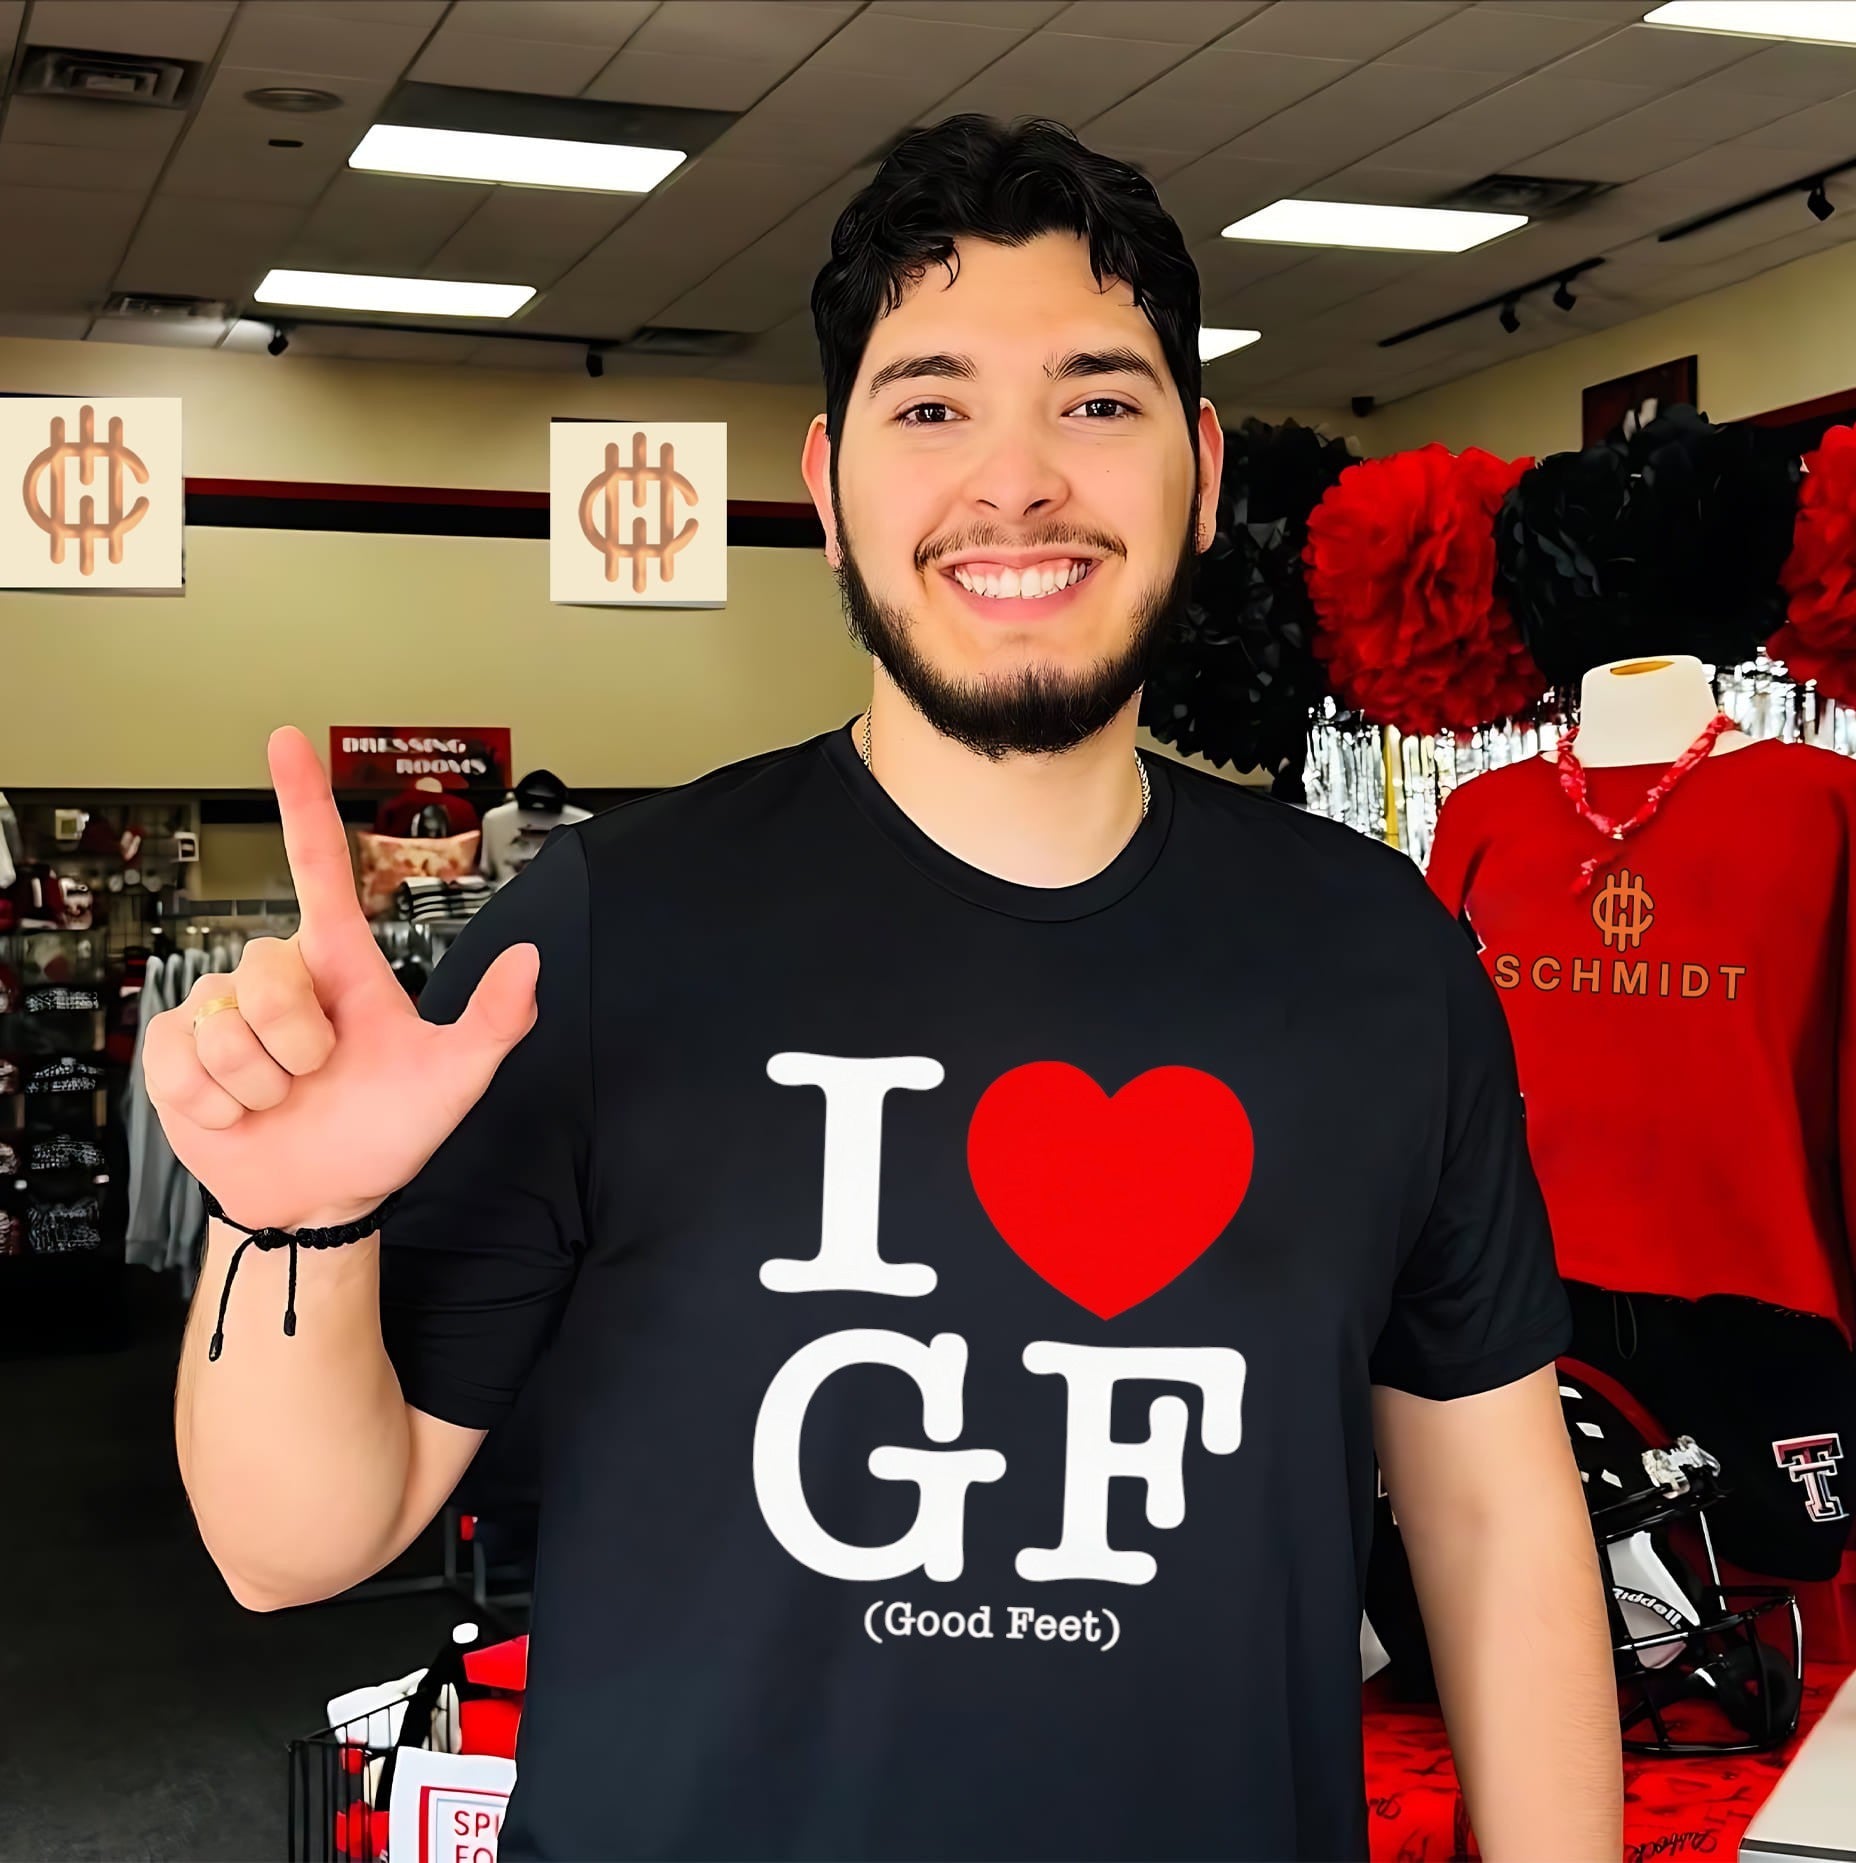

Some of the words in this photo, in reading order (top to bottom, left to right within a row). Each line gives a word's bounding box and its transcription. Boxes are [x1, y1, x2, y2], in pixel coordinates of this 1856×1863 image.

[395, 758, 488, 775] ROOMS
[1494, 955, 1747, 1000] SCHMIDT
[758, 1051, 945, 1298] I
[752, 1328, 1247, 1586] GF
[863, 1600, 995, 1644] (Good
[1005, 1606, 1121, 1652] Feet)
